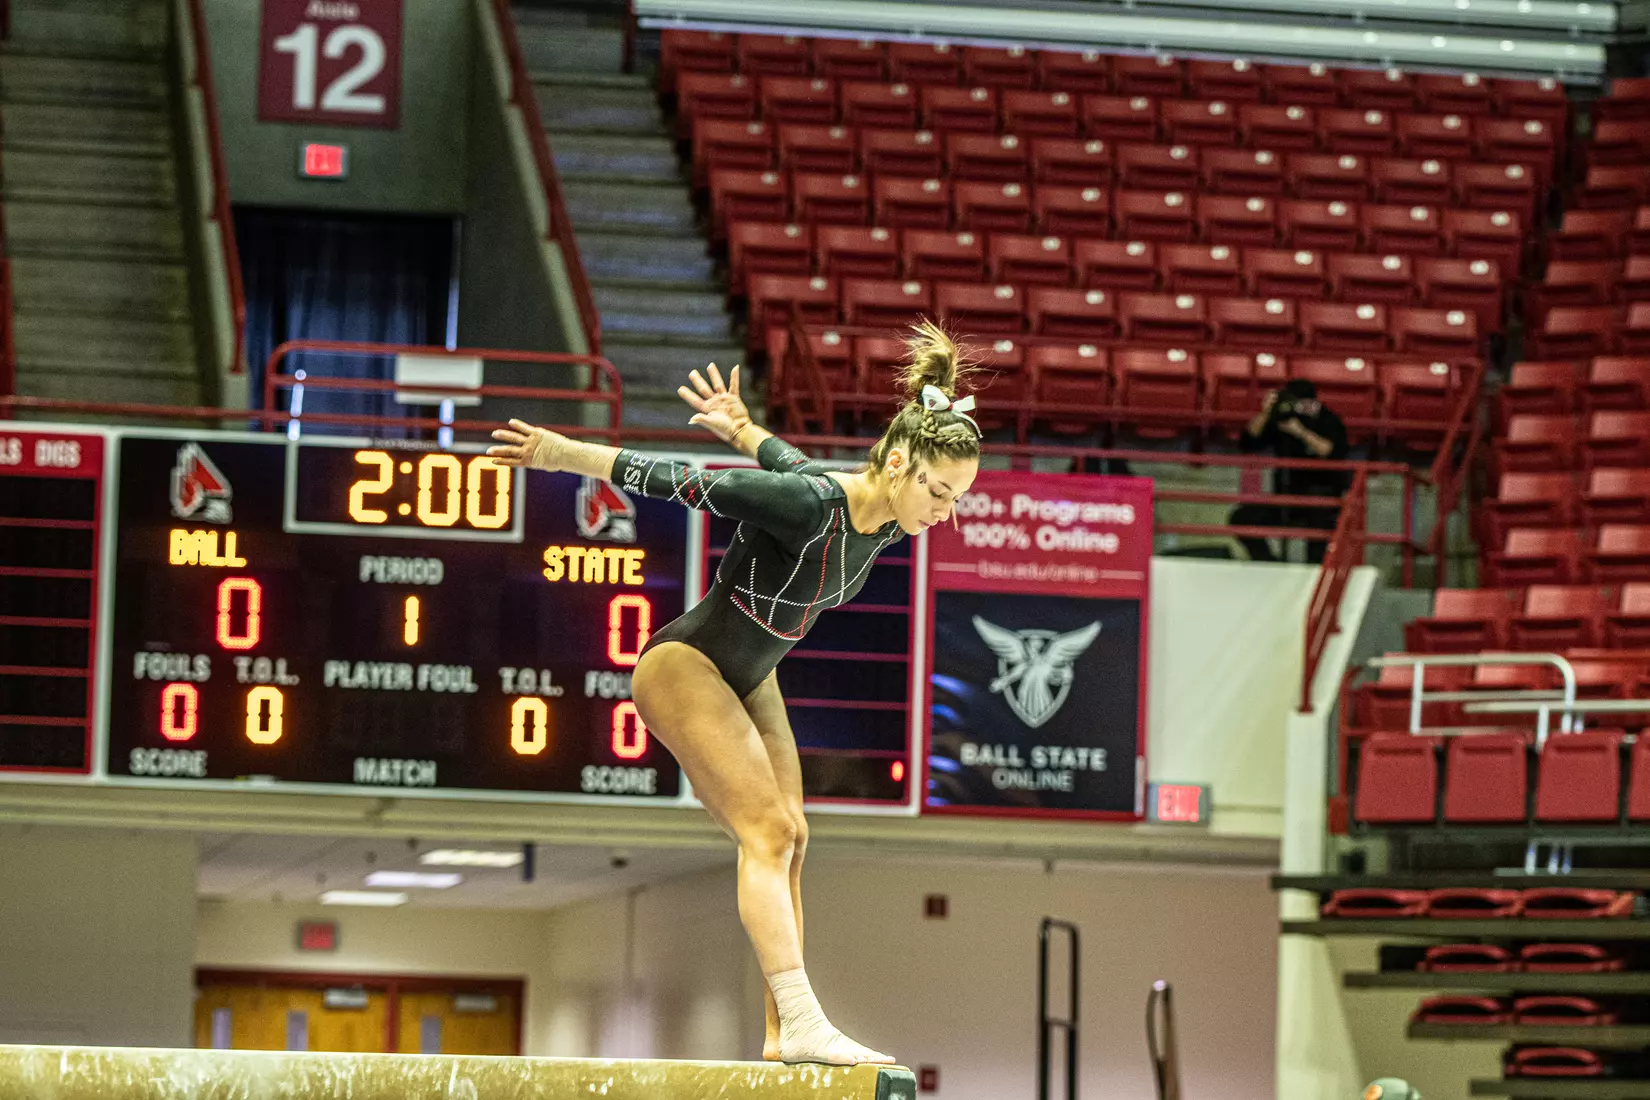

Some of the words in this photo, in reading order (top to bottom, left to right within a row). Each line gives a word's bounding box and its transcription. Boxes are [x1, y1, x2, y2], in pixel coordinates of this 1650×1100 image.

[274, 24, 386, 113] 12
[348, 451, 511, 528] 2:00
[955, 492, 1007, 518] 00+
[1011, 494, 1135, 526] Programs
[169, 529, 247, 567] BALL
[962, 524, 1031, 550] 100%
[1035, 525, 1120, 553] Online
[359, 556, 444, 585] PERIOD
[543, 546, 646, 585] STATE
[217, 577, 262, 649] 0
[404, 596, 419, 645] 1
[607, 594, 651, 666] 0
[134, 652, 211, 682] FOULS
[233, 656, 300, 685] T.O.L.
[324, 660, 412, 690] PLAYER
[417, 664, 478, 693] FOUL
[499, 667, 564, 696] T.O.L.
[585, 670, 633, 698] FOU
[160, 683, 198, 741] 0
[246, 686, 283, 744] 0
[511, 697, 547, 755] 0
[611, 701, 647, 759] 0
[130, 747, 208, 777] SCORE
[353, 757, 437, 786] MATCH
[960, 743, 1025, 768] BALL
[1030, 746, 1108, 771] STATE
[581, 765, 657, 794] SCORE
[992, 769, 1074, 792] ONLINE
